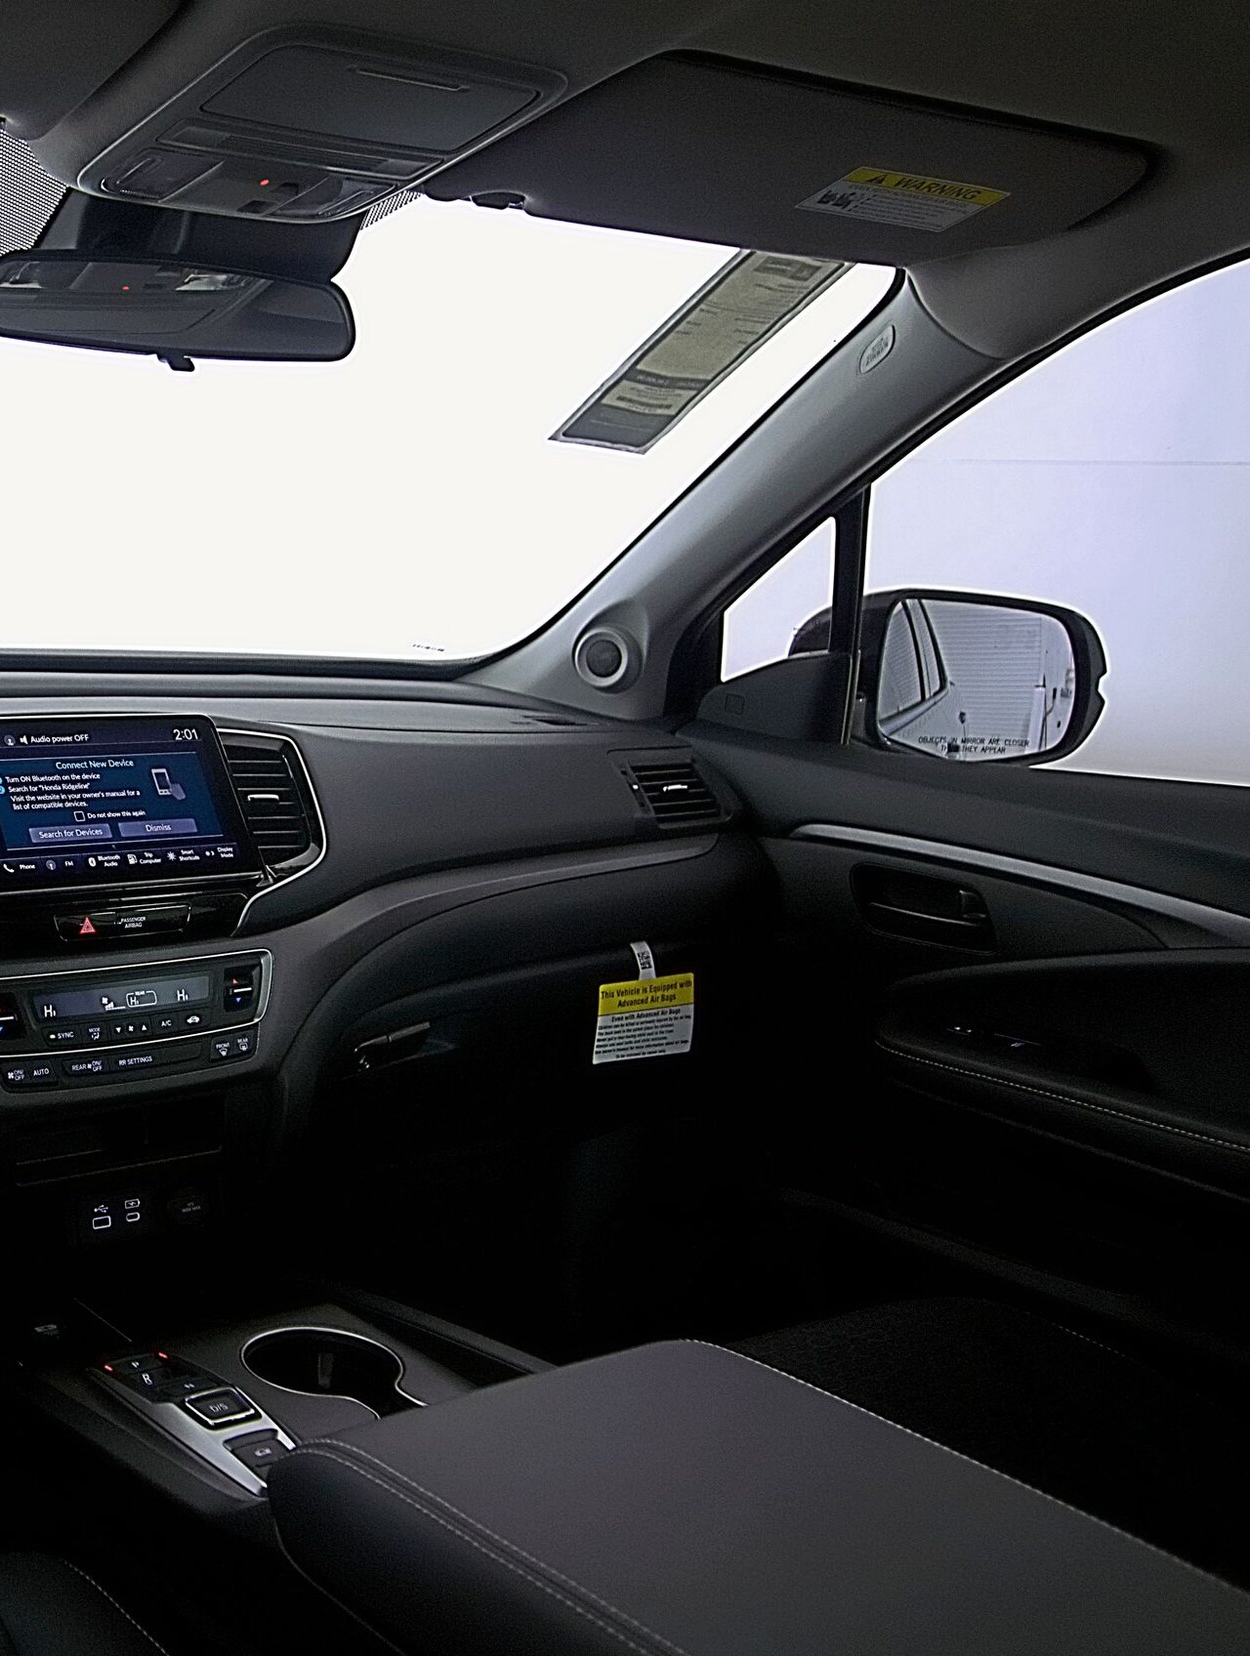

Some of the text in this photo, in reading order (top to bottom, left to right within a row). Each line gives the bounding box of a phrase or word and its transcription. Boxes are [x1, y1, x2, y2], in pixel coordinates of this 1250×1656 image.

[894, 177, 981, 201] WARNING
[31, 734, 90, 744] Audio power OFF
[173, 728, 199, 741] 2:01
[918, 735, 948, 745] OBJECTS
[960, 737, 986, 745] MIRROR
[987, 738, 1001, 746] ARE
[1003, 738, 1030, 747] CLOSER
[962, 745, 979, 753] THEY
[981, 746, 1007, 754] APPEAR
[55, 759, 135, 770] Connect New Device
[5, 776, 20, 784] Turn
[20, 775, 31, 783] ON
[32, 774, 61, 782] Bluetooth
[81, 772, 101, 780] device
[8, 785, 29, 793] Search
[29, 784, 39, 792] for
[10, 794, 26, 802] Visit
[27, 794, 37, 802] the
[36, 793, 60, 801] website
[68, 793, 82, 801] your
[127, 789, 136, 797] for
[12, 803, 23, 811] list
[31, 801, 64, 810] compatible
[64, 800, 89, 808] devices.
[107, 810, 121, 818] show
[121, 809, 132, 817] this
[145, 823, 172, 832] Dismiss
[39, 828, 103, 839] Search for Devices
[97, 854, 121, 862] Bluetooth
[121, 916, 147, 924] PASSENGER
[601, 990, 615, 1000] This
[616, 986, 641, 998] Vehicle
[649, 981, 678, 993] Equipped
[678, 979, 693, 989] with
[617, 992, 677, 1008] Advanced Air Bags
[161, 1018, 173, 1028] A/C
[56, 1031, 75, 1040] SYNC
[127, 1055, 154, 1066] SETTINGS
[33, 1067, 50, 1077] AUTO
[71, 1062, 88, 1072] REAR
[141, 1372, 153, 1387] R
[210, 1402, 229, 1414] D/S
